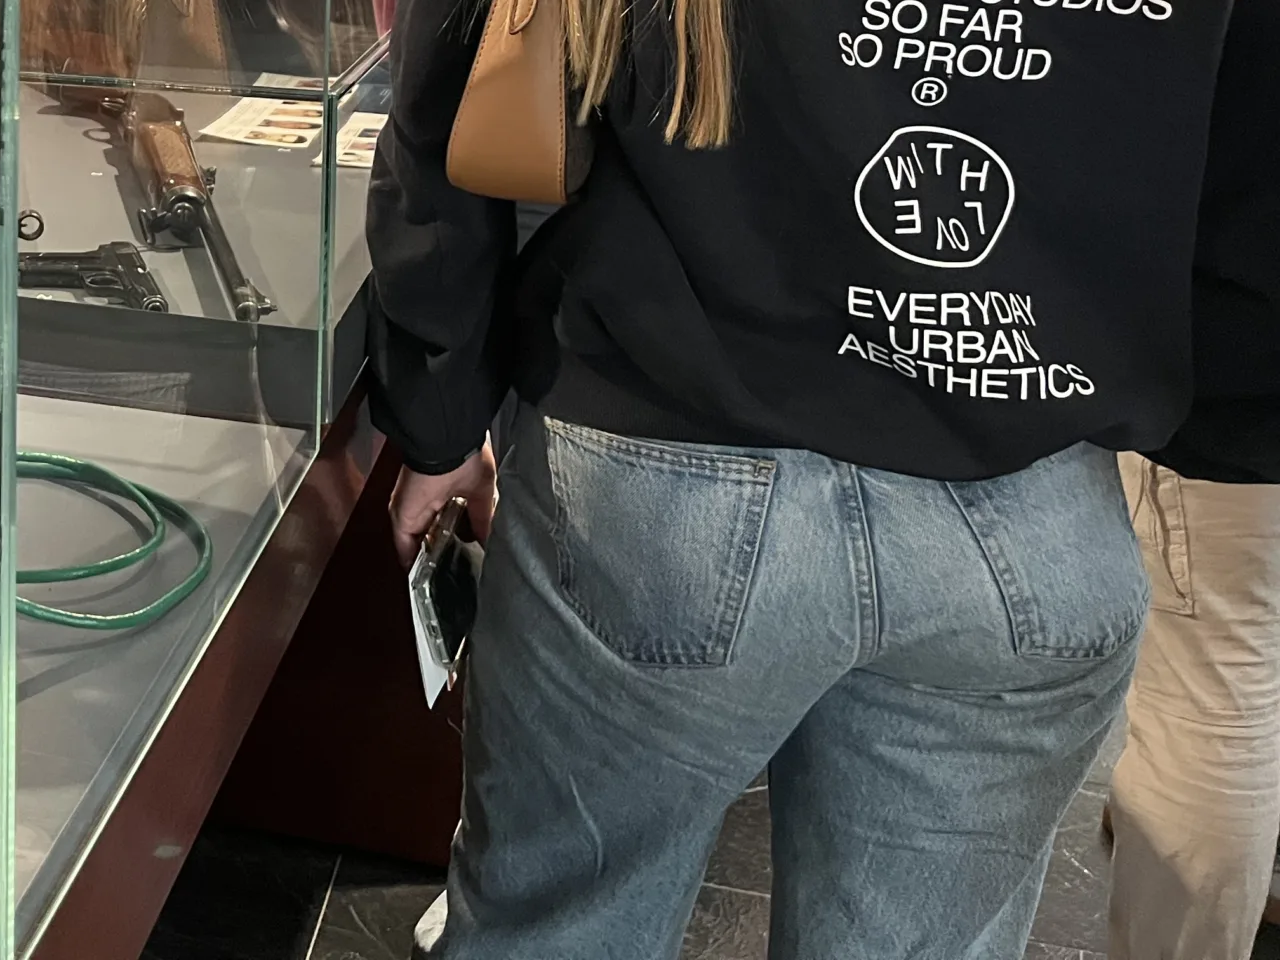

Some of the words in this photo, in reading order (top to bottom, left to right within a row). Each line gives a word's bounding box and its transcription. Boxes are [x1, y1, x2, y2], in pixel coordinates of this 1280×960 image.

[937, 2, 1024, 45] FAR
[837, 31, 884, 68] SO
[893, 36, 1053, 81] PROUD
[883, 141, 991, 192] WITH
[893, 199, 987, 252] LOVE
[846, 284, 1038, 328] EVERYDAY
[836, 332, 1096, 401] AESTHETICS
[887, 324, 1041, 365] URBAN
